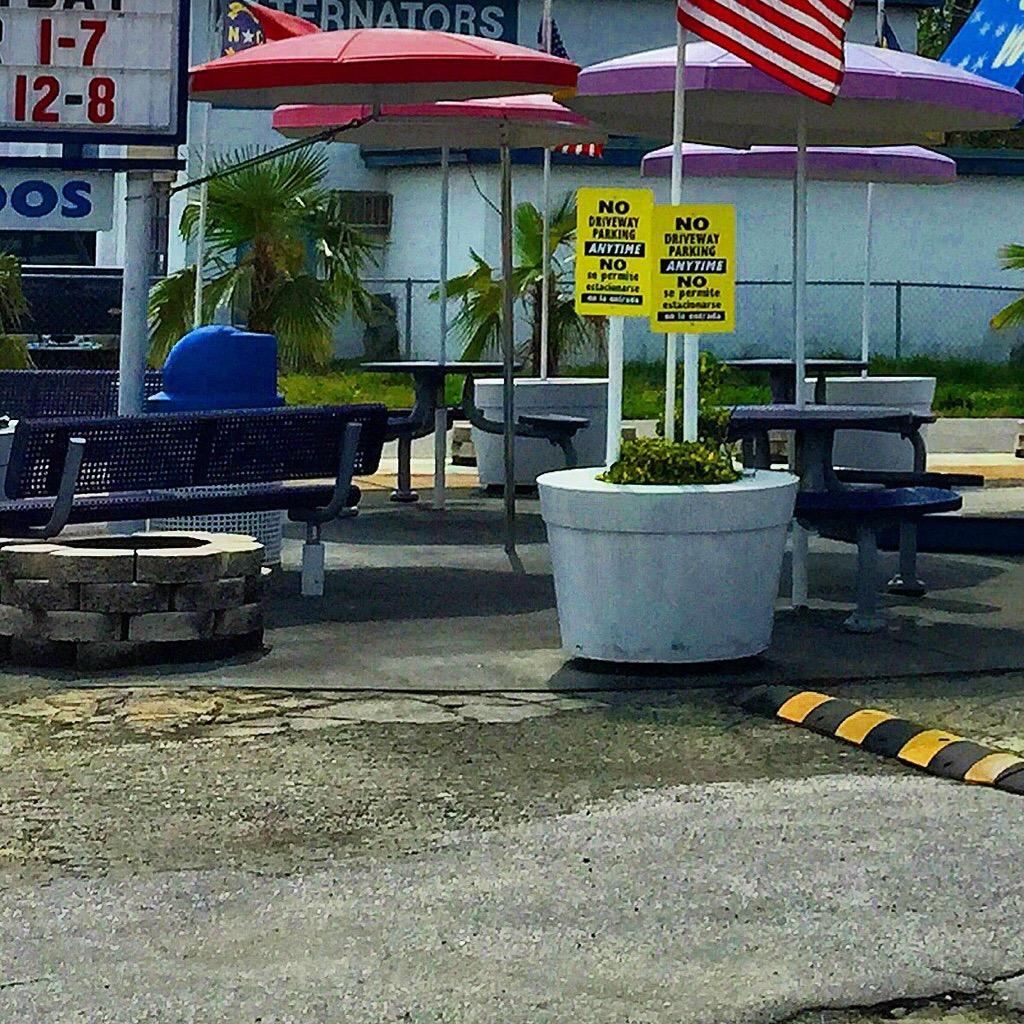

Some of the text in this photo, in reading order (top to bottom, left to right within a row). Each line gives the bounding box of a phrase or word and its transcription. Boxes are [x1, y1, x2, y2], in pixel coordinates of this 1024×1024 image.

[40, 19, 107, 66] 1-7
[15, 75, 115, 124] 12-8
[0, 180, 92, 218] OS
[599, 201, 630, 214] NO
[589, 217, 640, 228] DRIVEWAY
[675, 217, 709, 231] NO
[593, 229, 636, 240] PARKING
[664, 234, 719, 245] DRIVEWAY
[589, 243, 641, 255] ANYTIME
[669, 246, 716, 257] PARKING
[600, 259, 627, 271] NO
[666, 260, 725, 272] ANYTIME
[677, 276, 707, 288] NO
[664, 288, 720, 300] se permite
[663, 300, 721, 309] estacionarse
